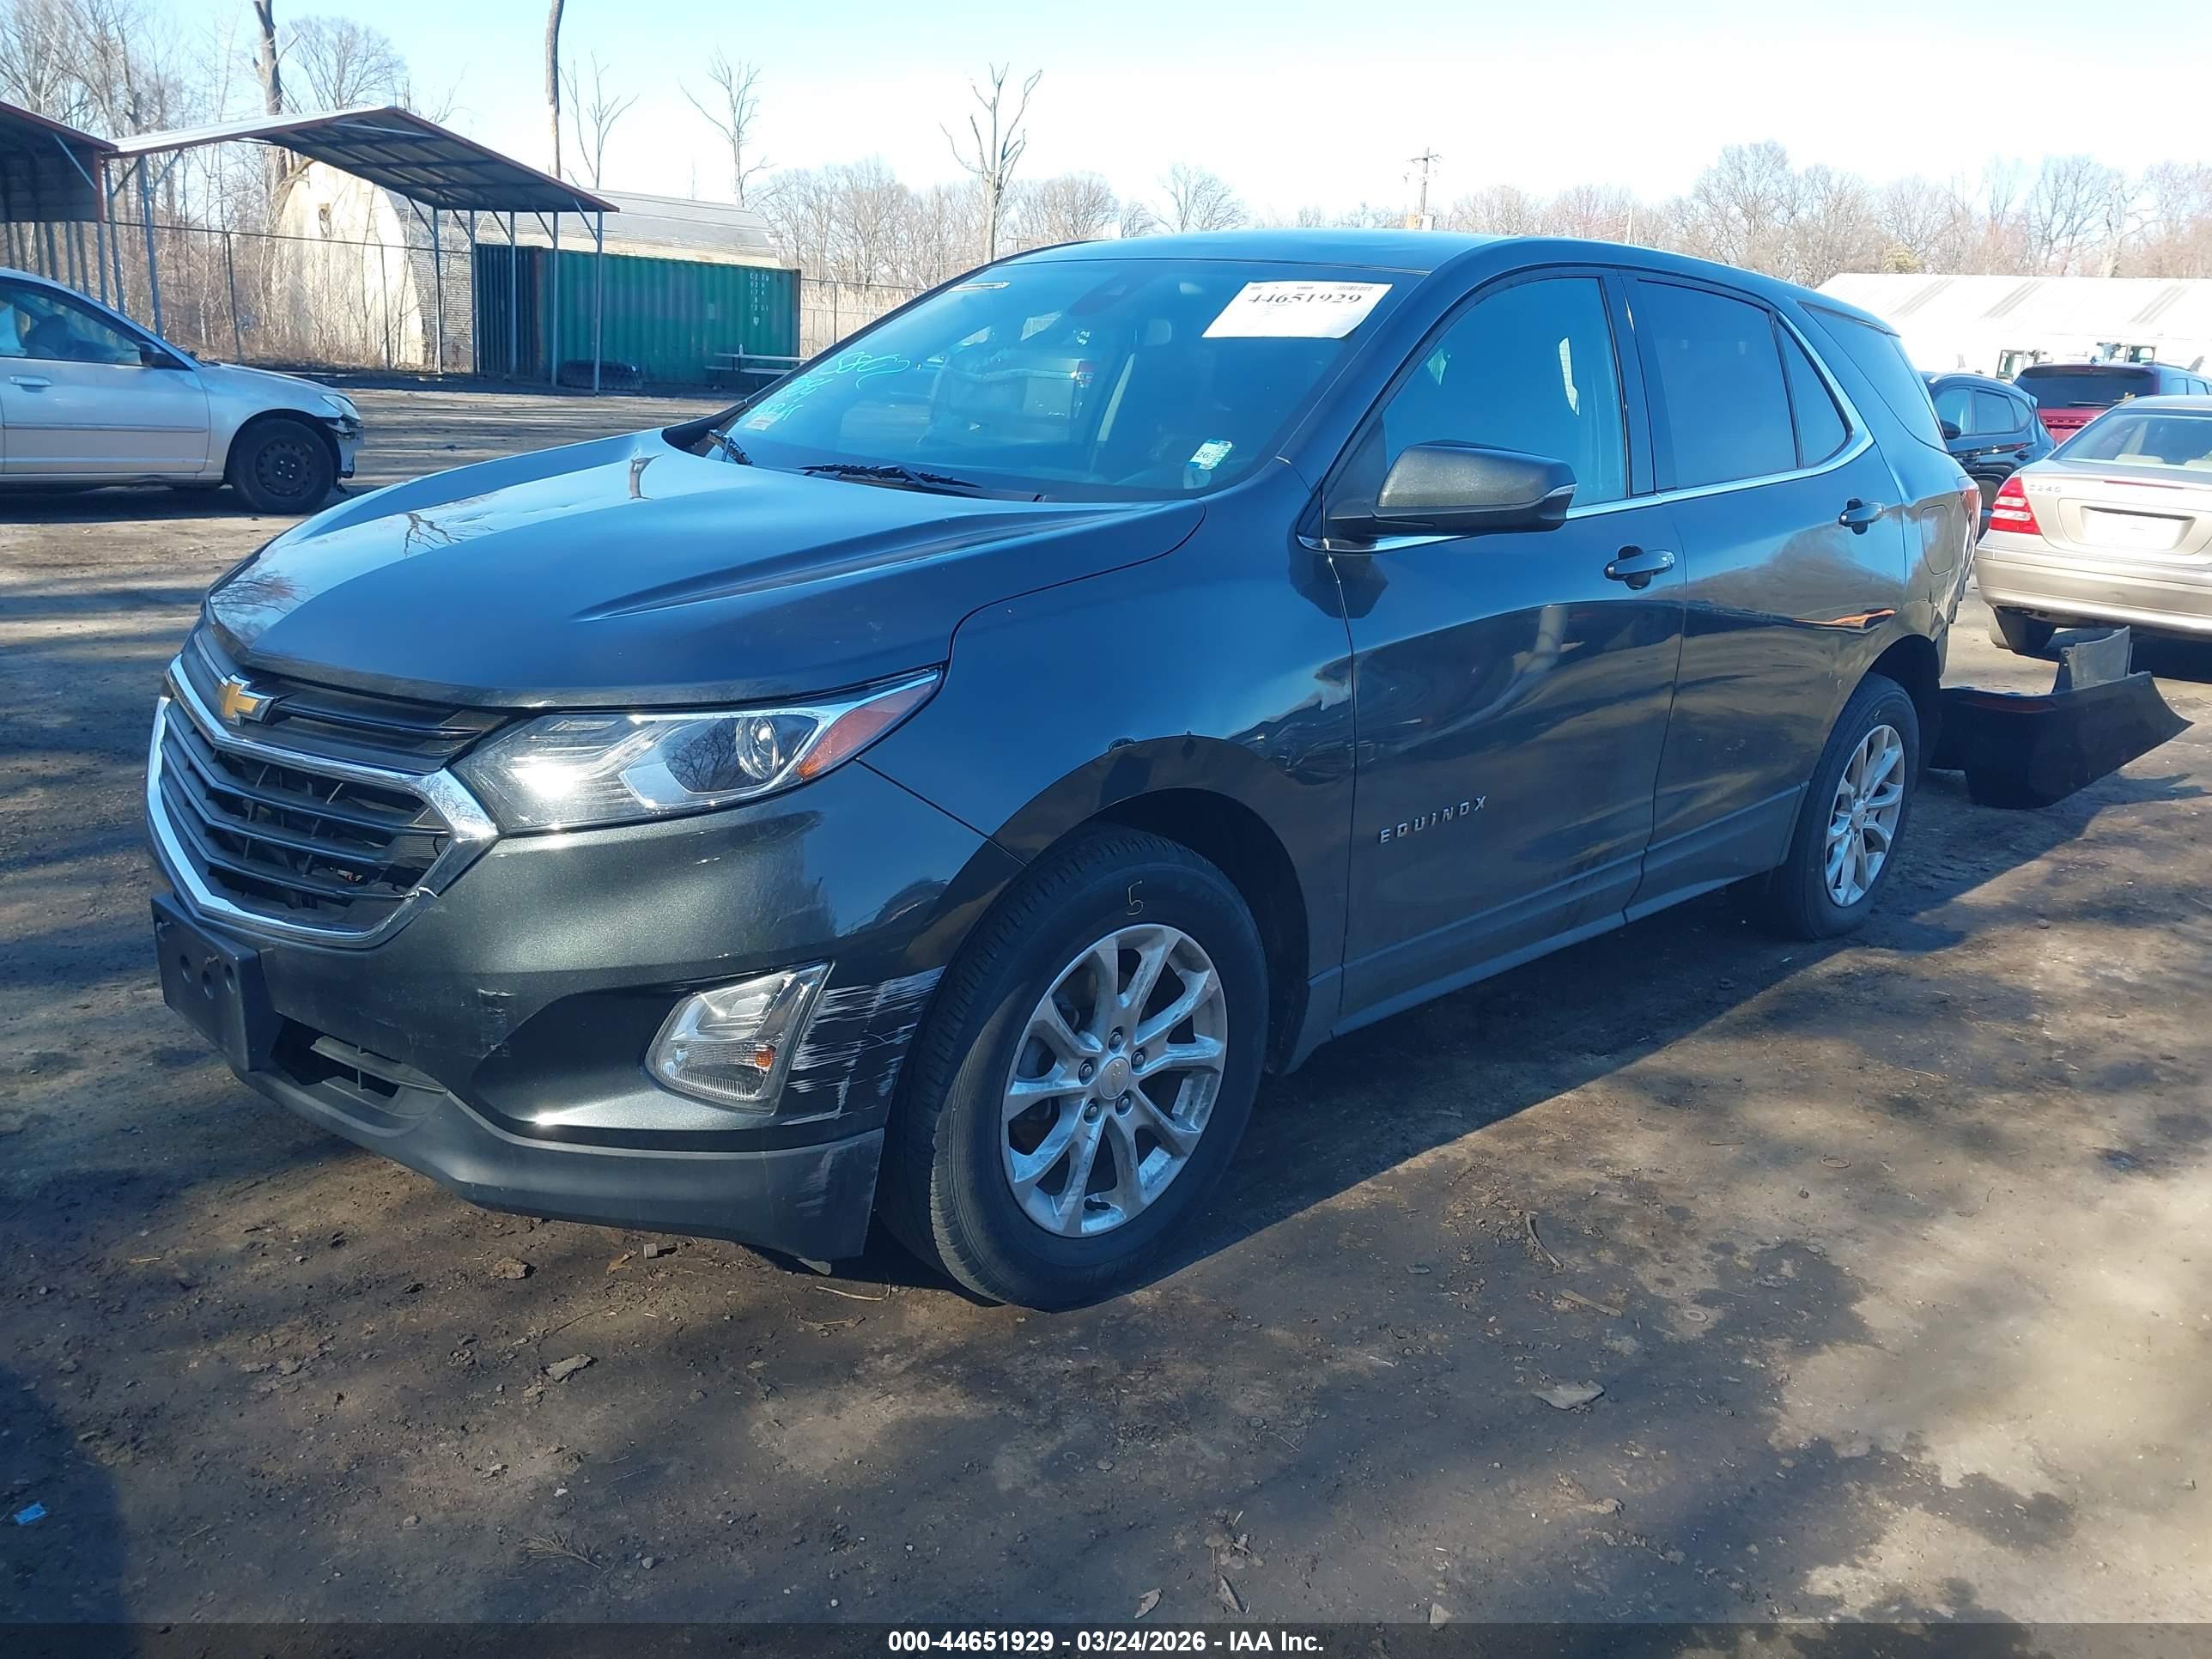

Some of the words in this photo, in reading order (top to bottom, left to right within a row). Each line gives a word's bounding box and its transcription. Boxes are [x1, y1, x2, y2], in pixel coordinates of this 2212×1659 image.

[1249, 293, 1363, 304] 44651929
[1379, 795, 1487, 844] EQUINOX
[1127, 879, 1144, 916] 5
